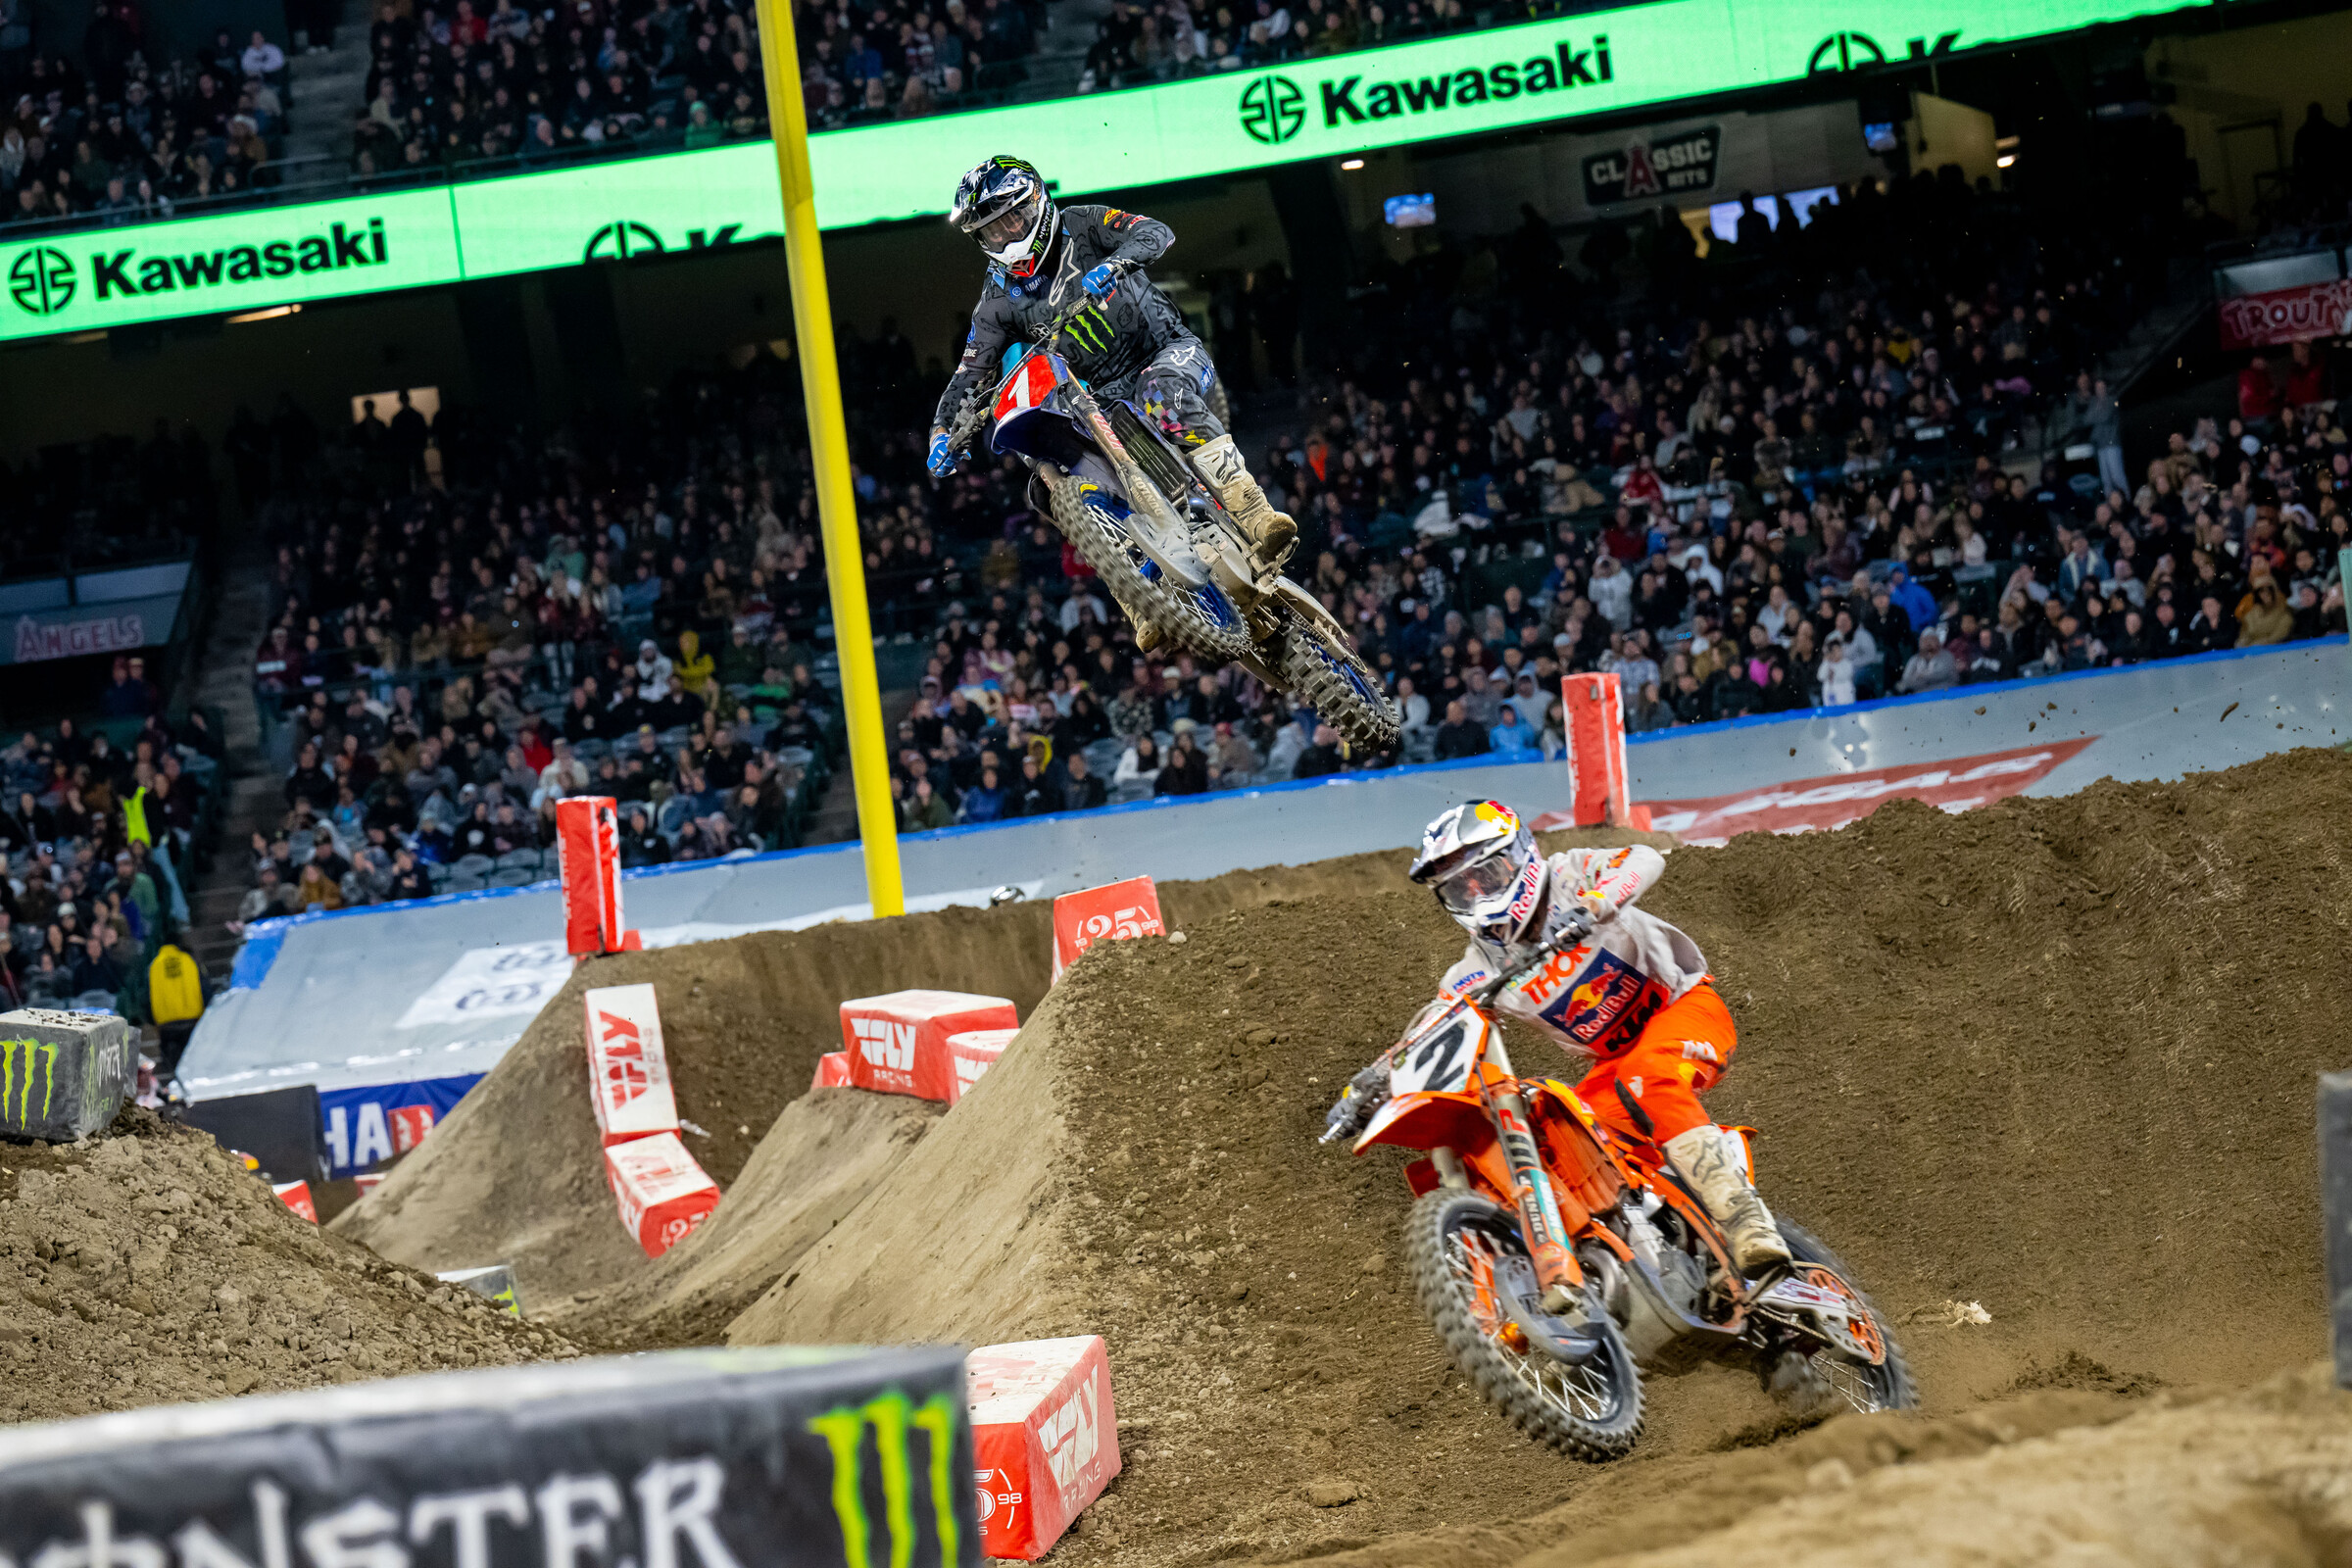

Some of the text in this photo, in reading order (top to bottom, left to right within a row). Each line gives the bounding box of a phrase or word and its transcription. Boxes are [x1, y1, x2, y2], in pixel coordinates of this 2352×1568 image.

[1321, 36, 1612, 127] Kawasaki
[1592, 137, 1712, 196] CLASSIC
[92, 218, 388, 300] Kawasaki
[1007, 367, 1030, 408] 1
[14, 614, 145, 662] ANGELS
[850, 1017, 916, 1071] FLY
[1605, 990, 1664, 1053] KTM
[1414, 1019, 1465, 1092] 2
[1520, 1175, 1544, 1232] DUNLP
[1038, 1363, 1099, 1492] FLY
[998, 1493, 1022, 1505] 98
